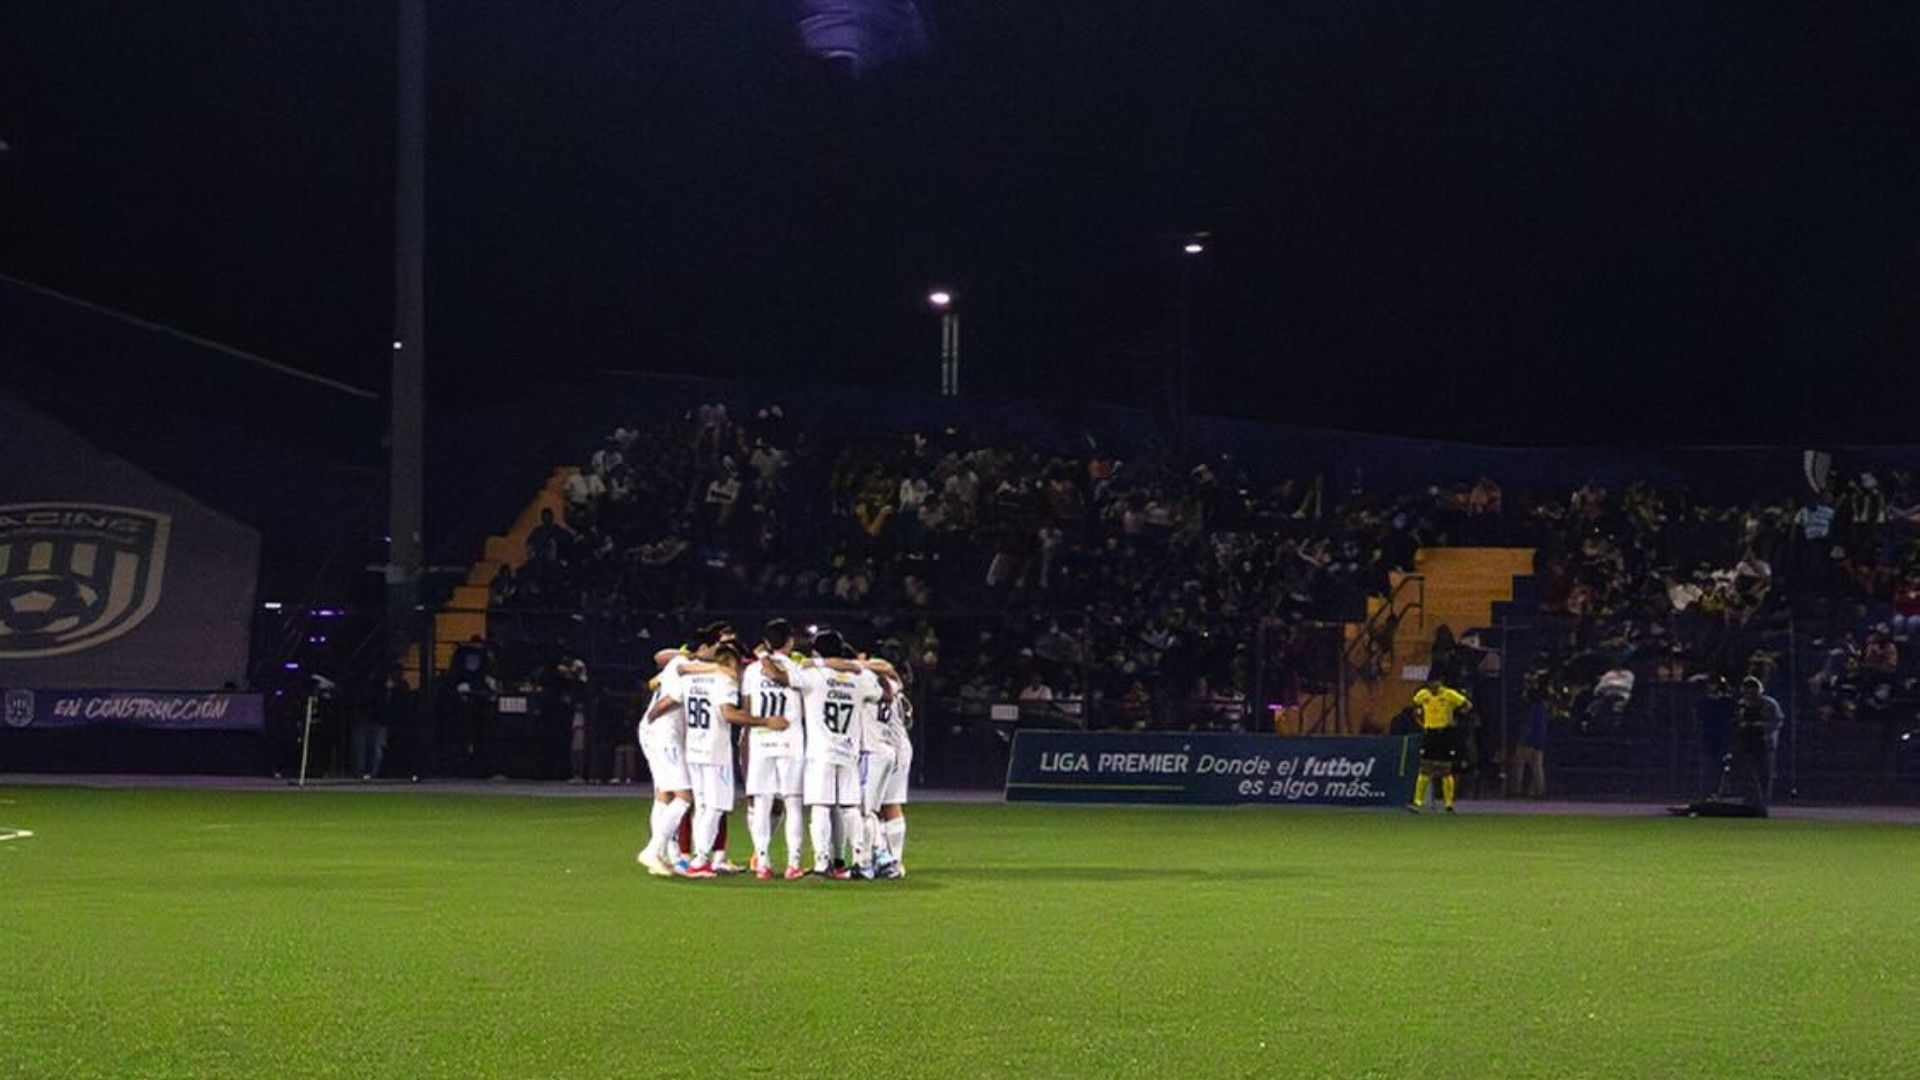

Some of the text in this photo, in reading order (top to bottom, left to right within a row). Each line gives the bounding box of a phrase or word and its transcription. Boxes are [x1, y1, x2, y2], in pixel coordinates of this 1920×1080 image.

[54, 698, 81, 717] EN
[823, 701, 855, 734] 87
[1040, 752, 1376, 779] LIGA PREMIER Donde el futbol
[1238, 777, 1386, 800] es algo más...
